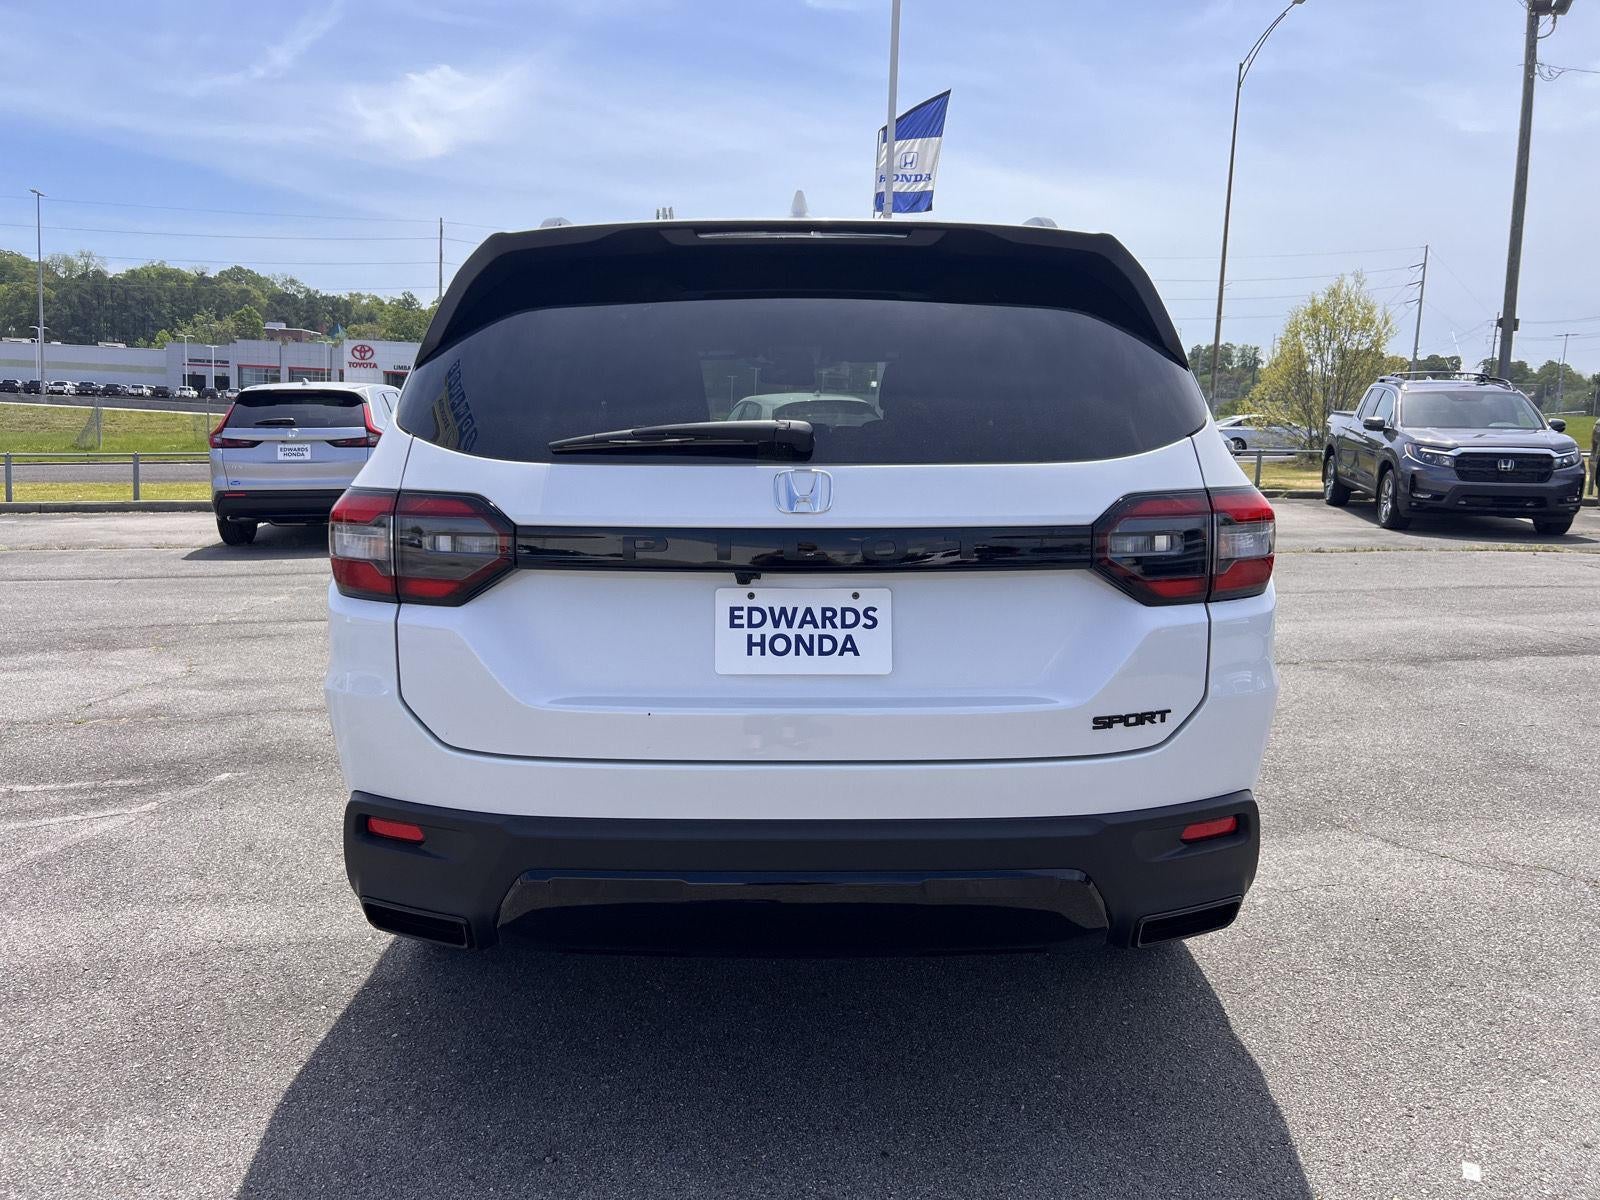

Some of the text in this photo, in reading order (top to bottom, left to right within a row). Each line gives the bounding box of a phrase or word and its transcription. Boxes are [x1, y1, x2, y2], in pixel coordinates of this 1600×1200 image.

[348, 361, 378, 369] TOYOTA
[622, 536, 990, 561] PILOT
[729, 606, 878, 629] EDWARDS
[746, 633, 860, 657] HONDA
[1092, 709, 1171, 730] SPORT
